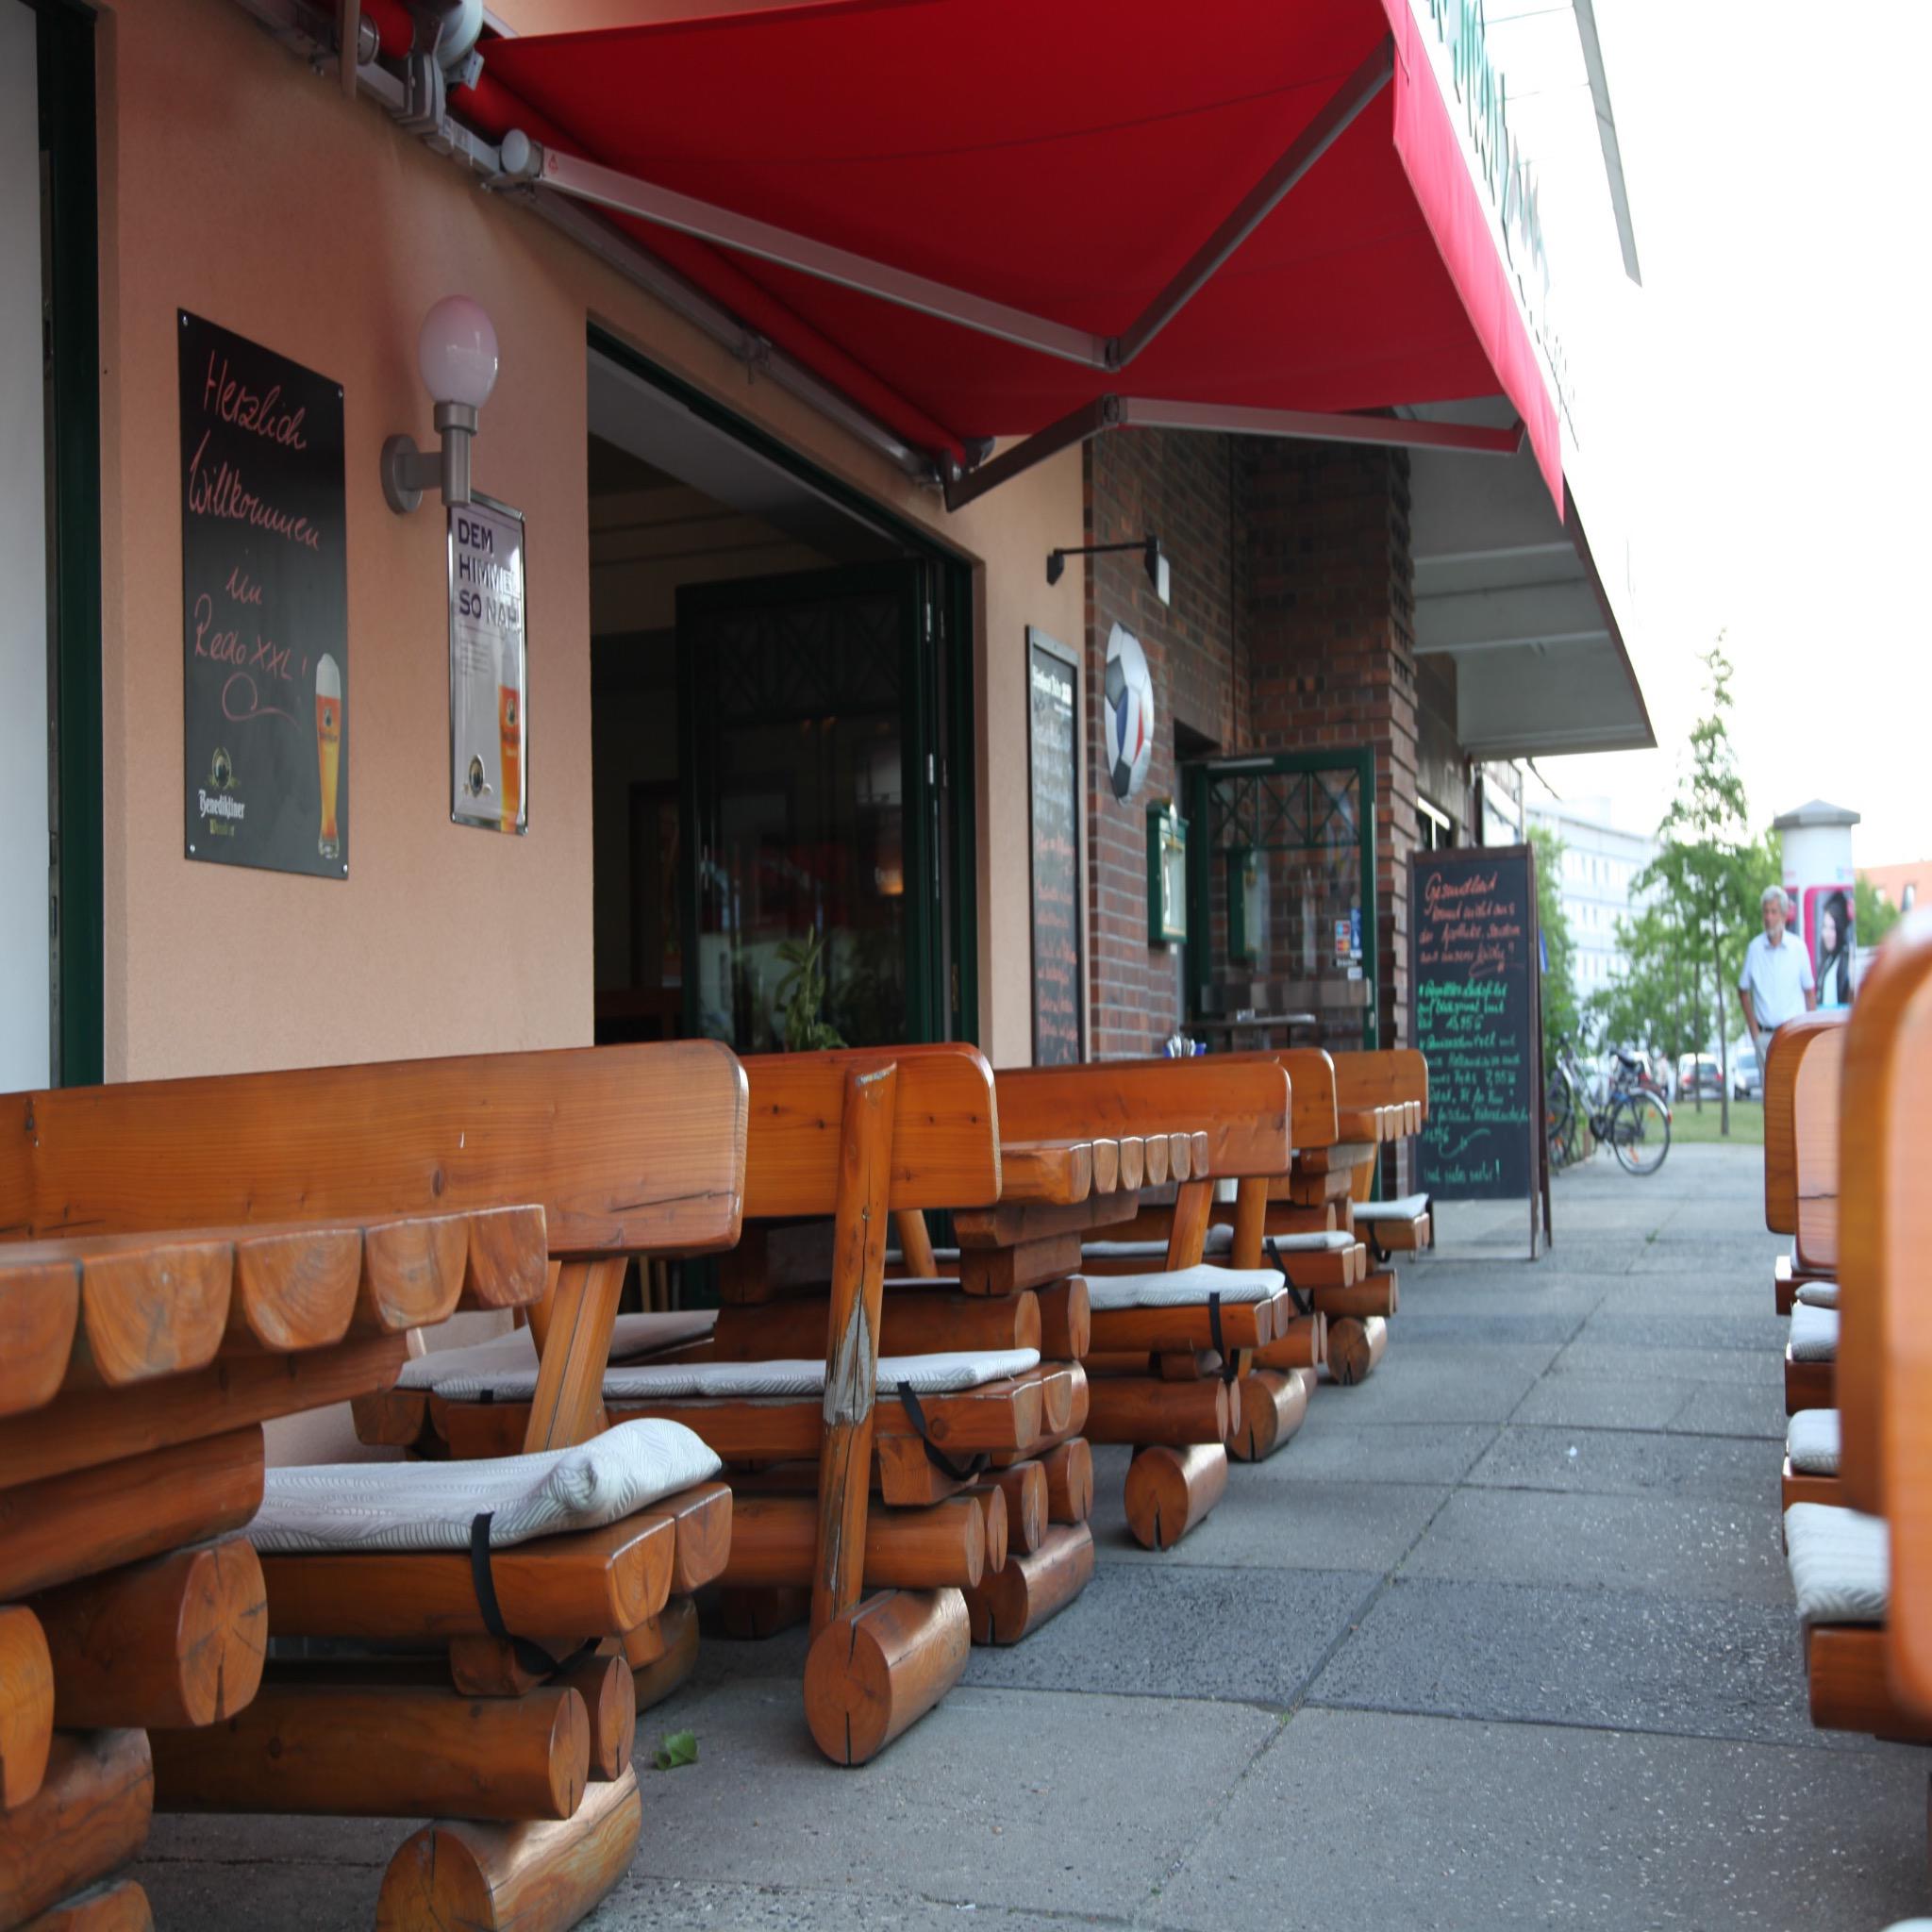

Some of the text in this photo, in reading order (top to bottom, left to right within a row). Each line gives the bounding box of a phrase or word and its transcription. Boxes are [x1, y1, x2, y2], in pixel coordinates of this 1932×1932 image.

[203, 349, 307, 450] Herzlich
[189, 429, 320, 550] Willkommen
[458, 517, 493, 554] DEM
[458, 553, 516, 594] HIMME
[458, 589, 482, 620] SO
